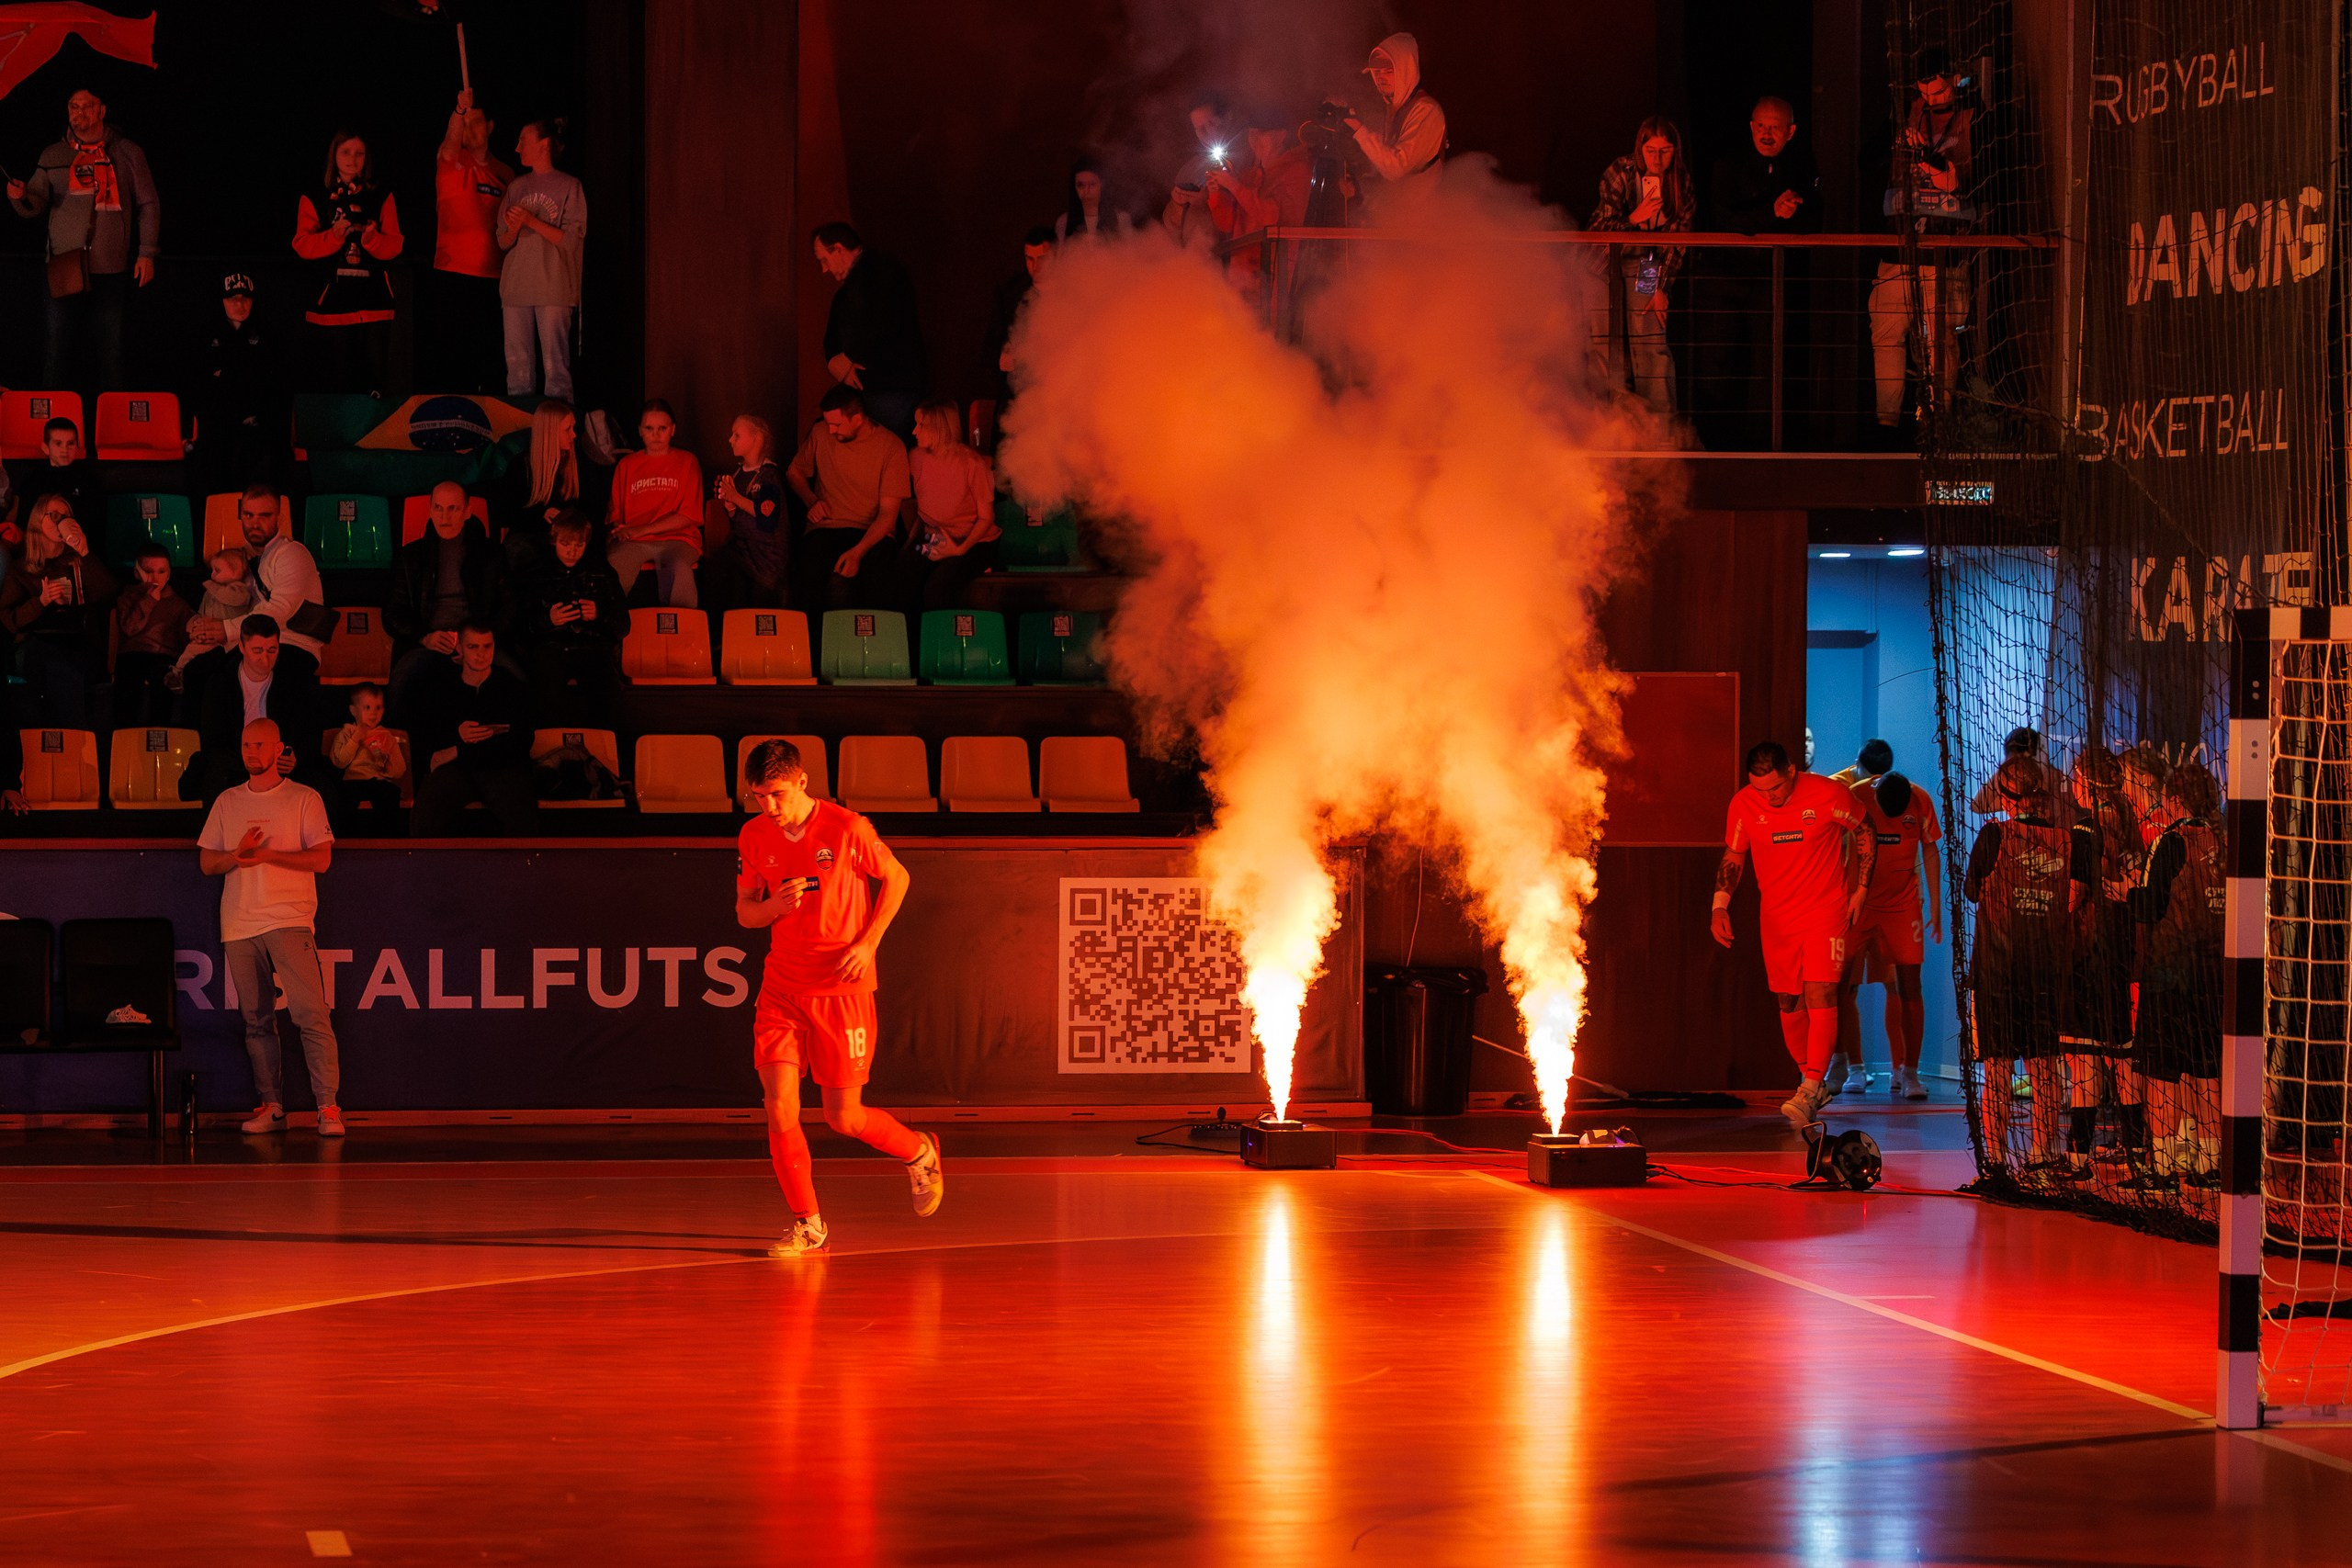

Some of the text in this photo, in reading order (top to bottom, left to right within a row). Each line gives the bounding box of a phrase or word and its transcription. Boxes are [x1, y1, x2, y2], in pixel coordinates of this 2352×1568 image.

[2089, 41, 2275, 126] RUGBYBALL
[2126, 185, 2327, 307] DANCING
[2075, 388, 2289, 463] BASKETBALL
[1828, 936, 1846, 962] 19
[845, 1027, 866, 1059] 18
